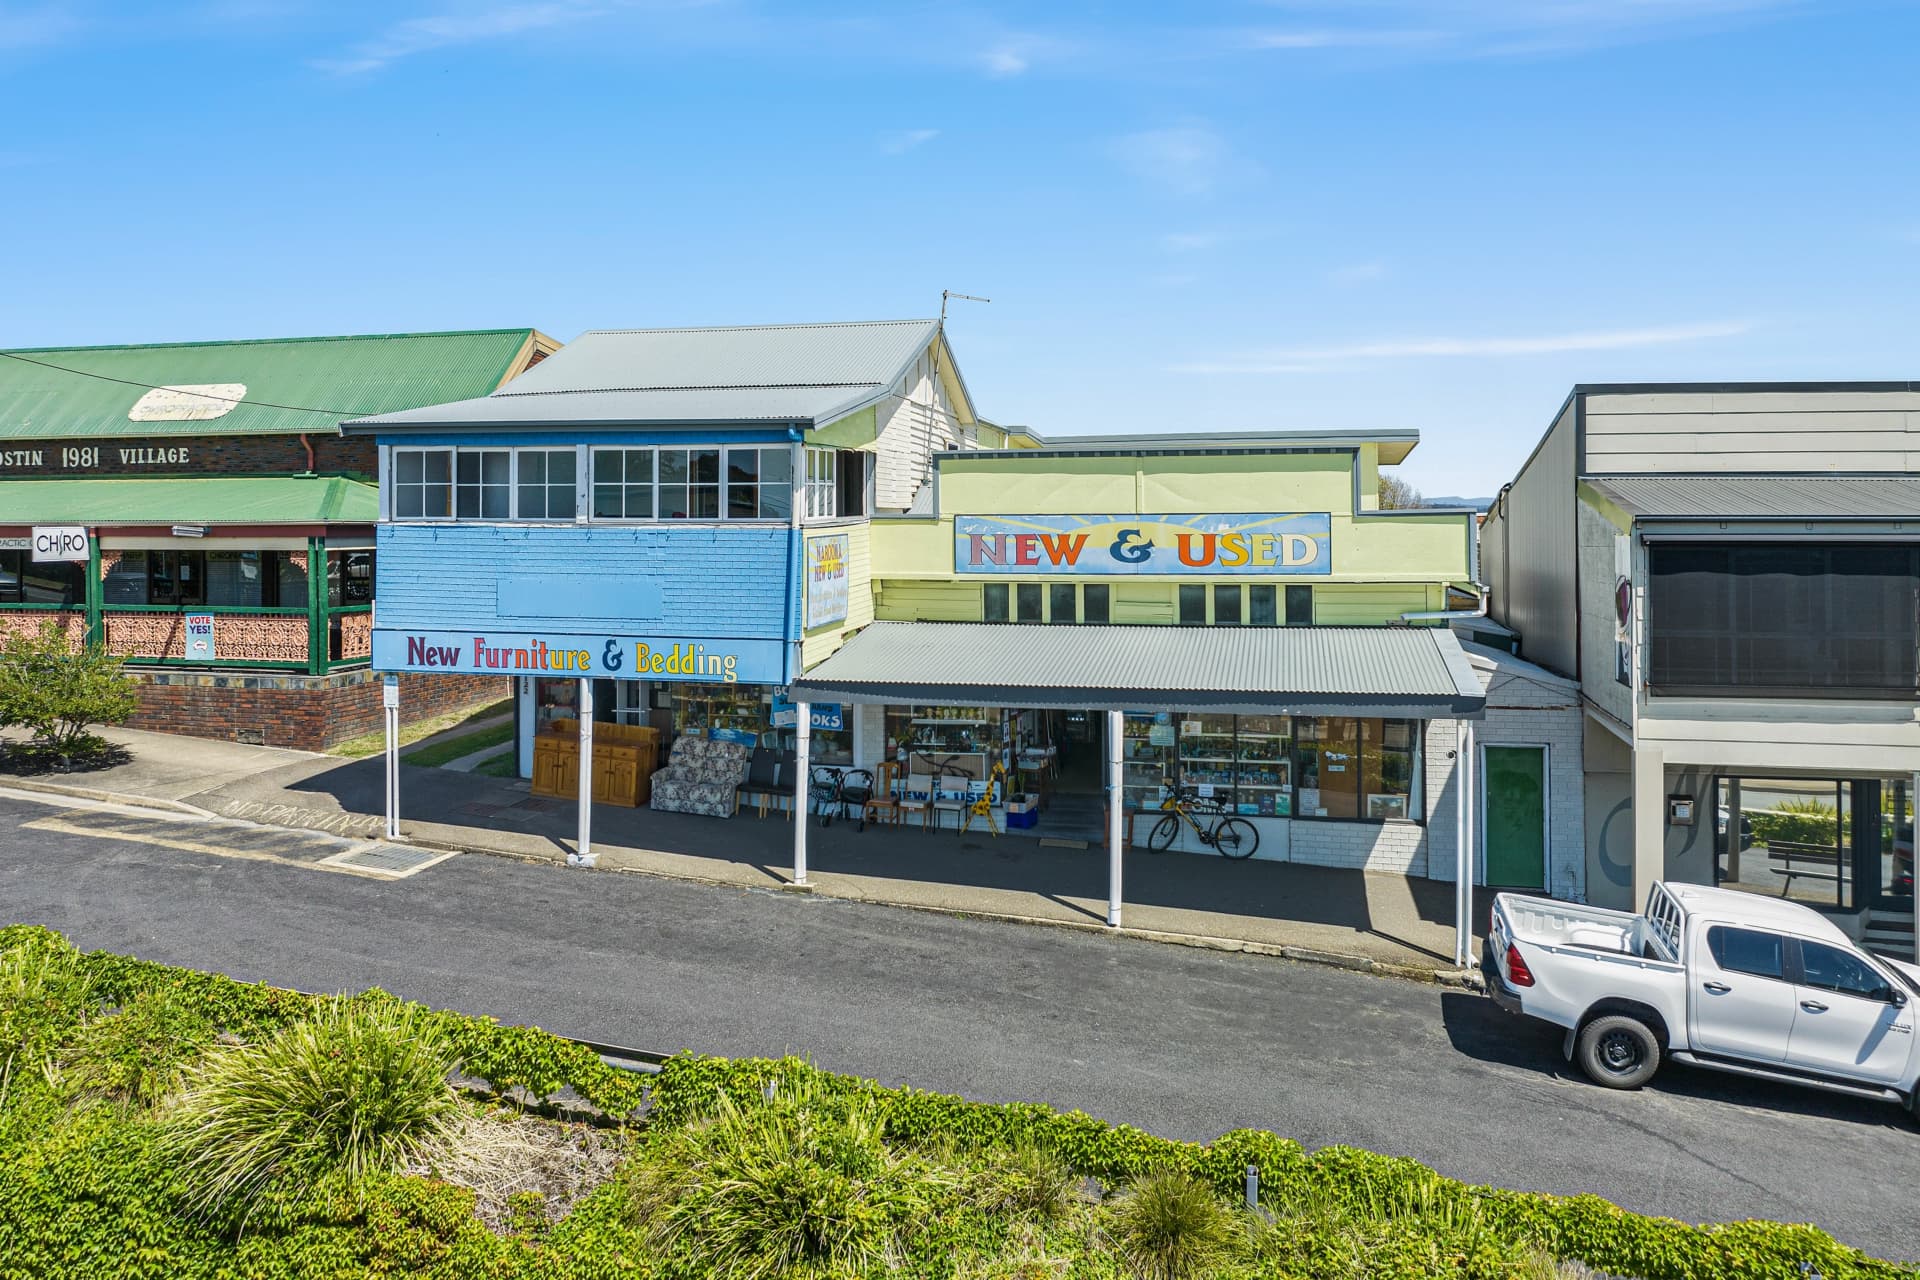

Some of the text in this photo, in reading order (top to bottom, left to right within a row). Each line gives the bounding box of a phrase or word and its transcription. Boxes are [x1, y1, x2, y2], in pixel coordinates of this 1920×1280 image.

[0, 447, 190, 468] STIN 1981 VILLAGE
[36, 530, 85, 556] CHIRO
[968, 529, 1320, 567] NEW & USED
[815, 564, 826, 582] NEW
[833, 562, 845, 579] USED
[189, 616, 211, 624] VOTE
[189, 625, 211, 634] YES!
[407, 636, 739, 683] New Furniture & Bedding
[811, 713, 841, 728] OKS
